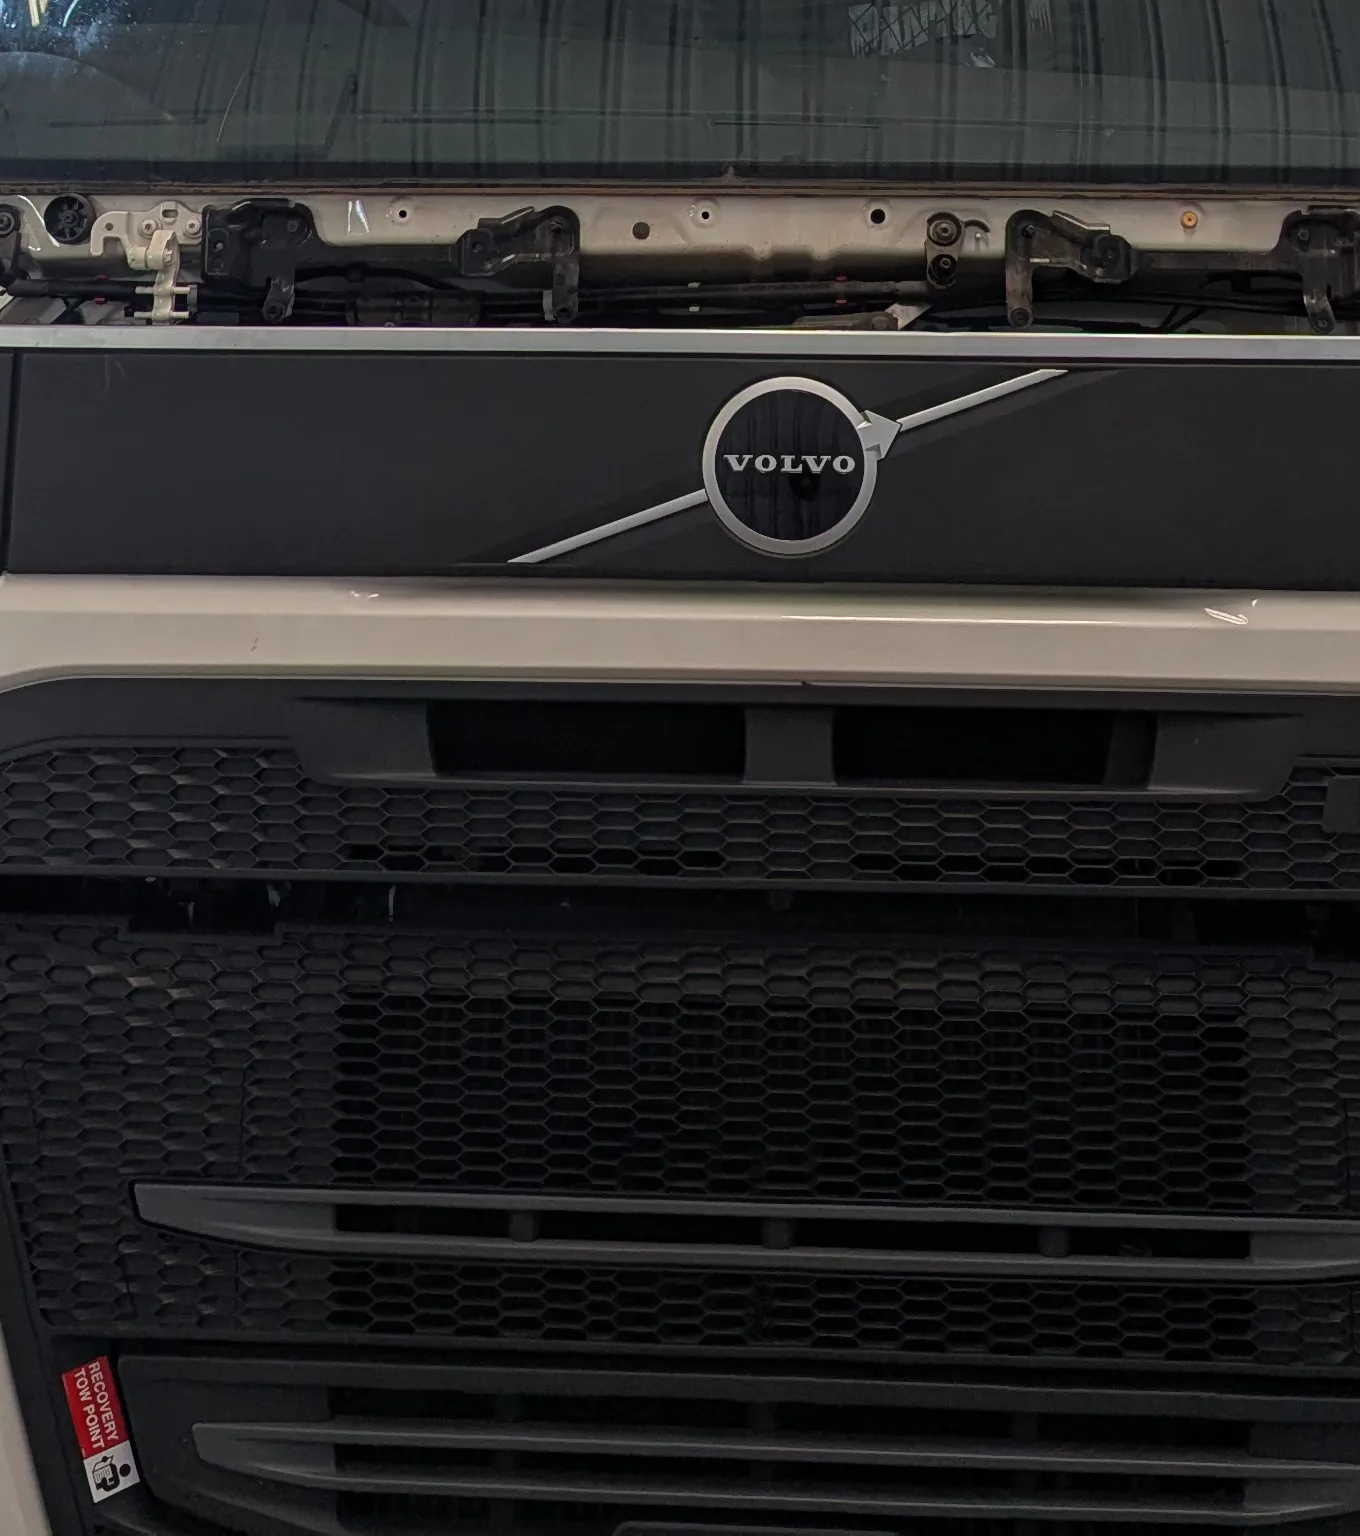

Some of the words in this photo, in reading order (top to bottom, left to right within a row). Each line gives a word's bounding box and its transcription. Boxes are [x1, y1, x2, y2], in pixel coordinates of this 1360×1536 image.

[723, 454, 856, 474] VOLVO
[73, 1367, 92, 1402] TOW
[83, 1404, 106, 1449] POINT
[89, 1361, 120, 1441] RECOVERY
